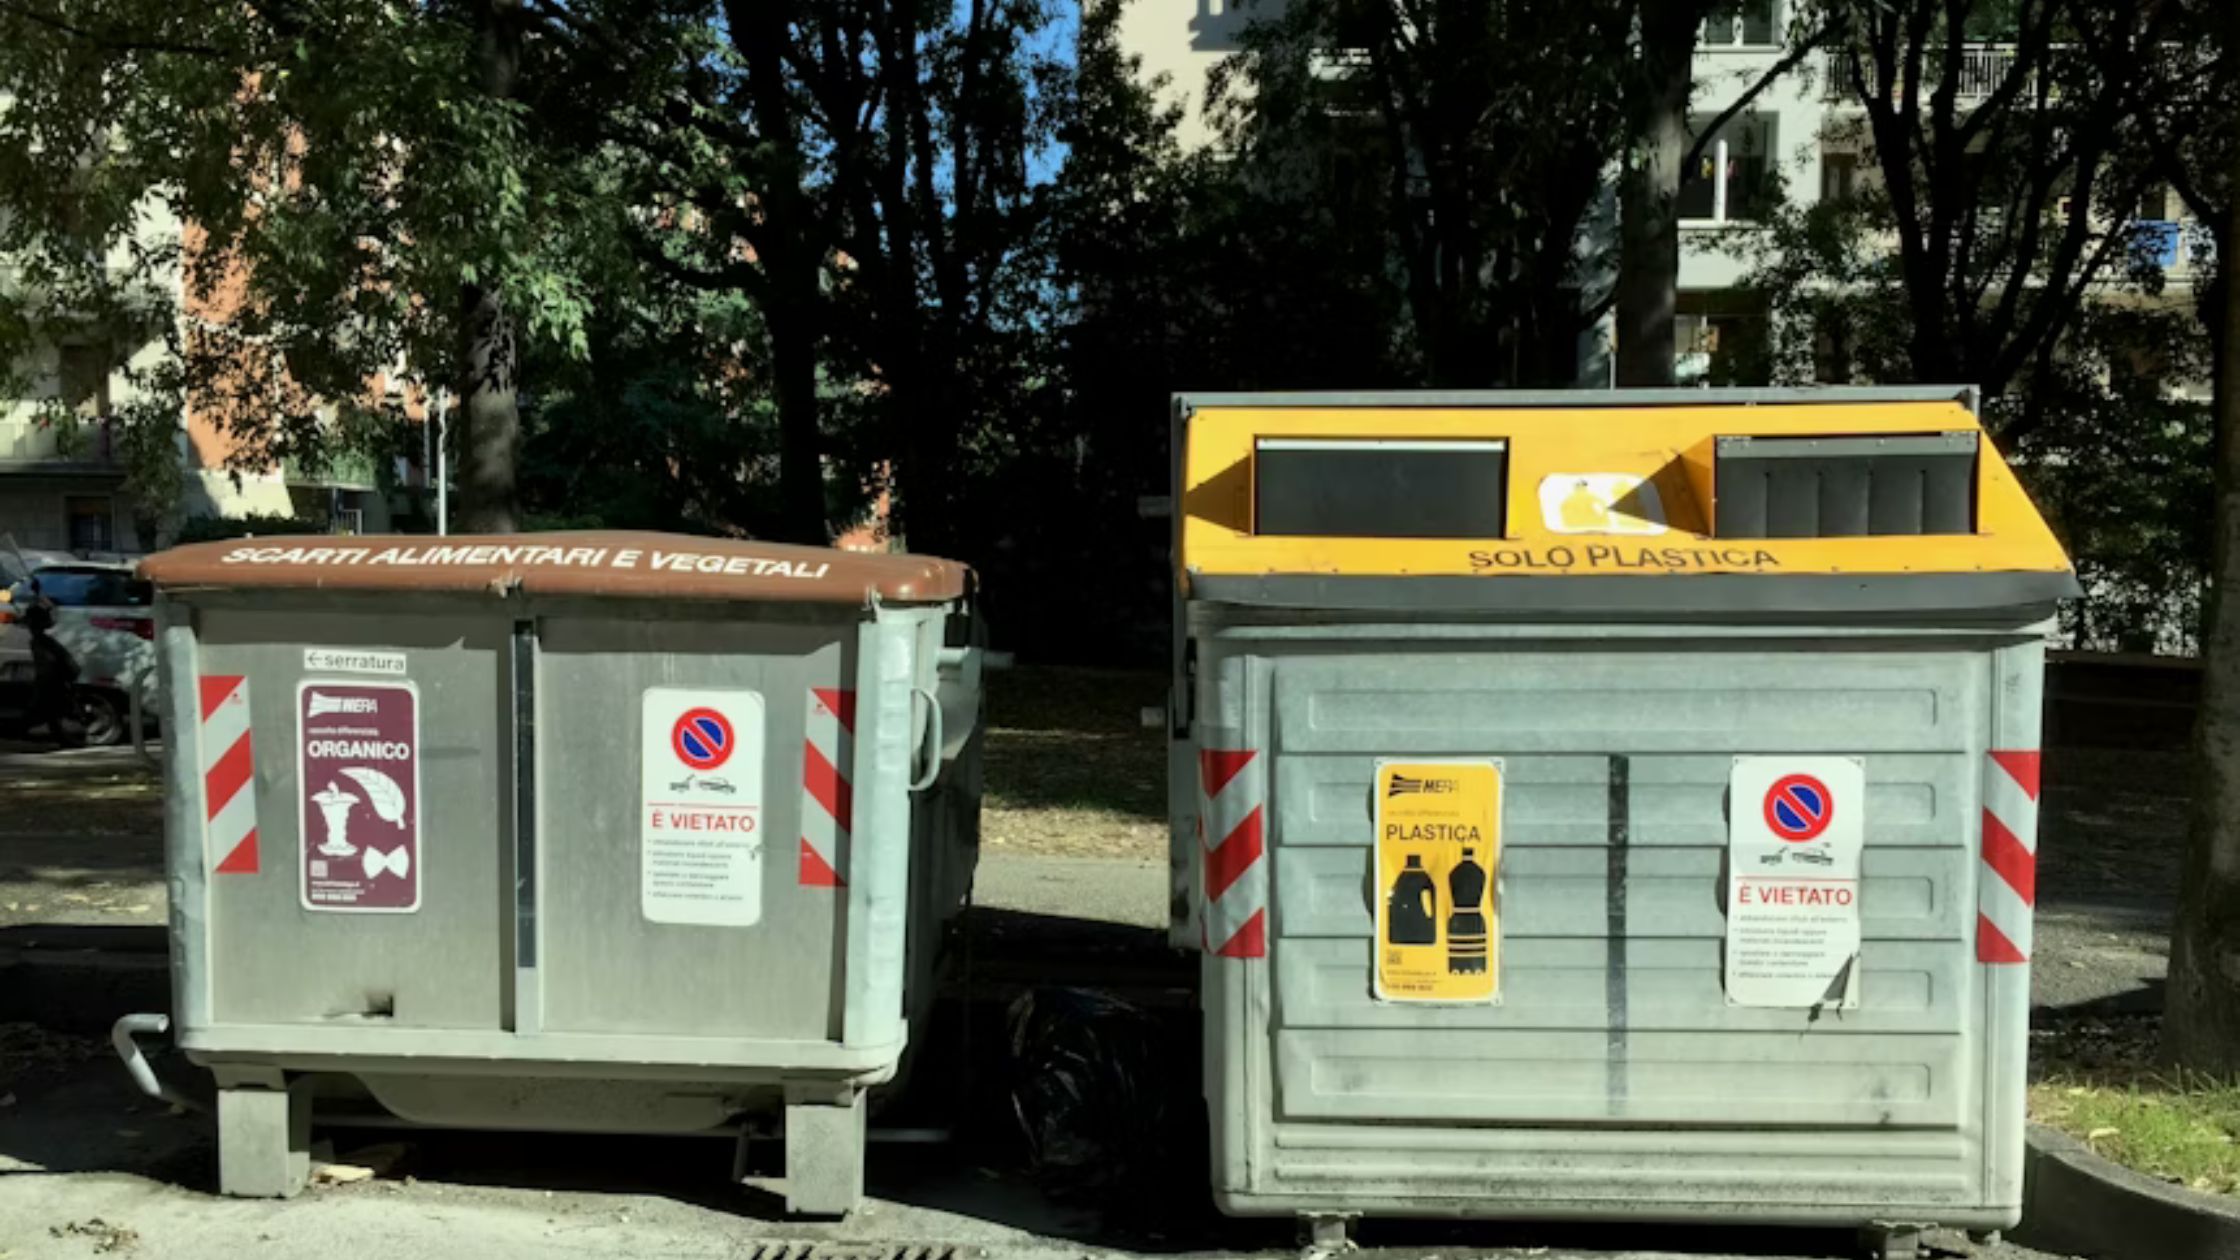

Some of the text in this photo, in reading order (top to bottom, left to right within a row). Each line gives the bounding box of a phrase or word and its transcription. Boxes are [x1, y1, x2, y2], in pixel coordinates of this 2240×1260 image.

[221, 545, 829, 578] SCARTI ALIMENTARI E VEGETALI
[1469, 544, 1780, 568] SOLO PLASTICA
[324, 653, 405, 671] serratura
[308, 740, 410, 760] ORGANICO
[651, 809, 756, 832] È VIETATO
[1386, 823, 1481, 842] PLASTICA
[1738, 882, 1853, 906] È VIETATO
